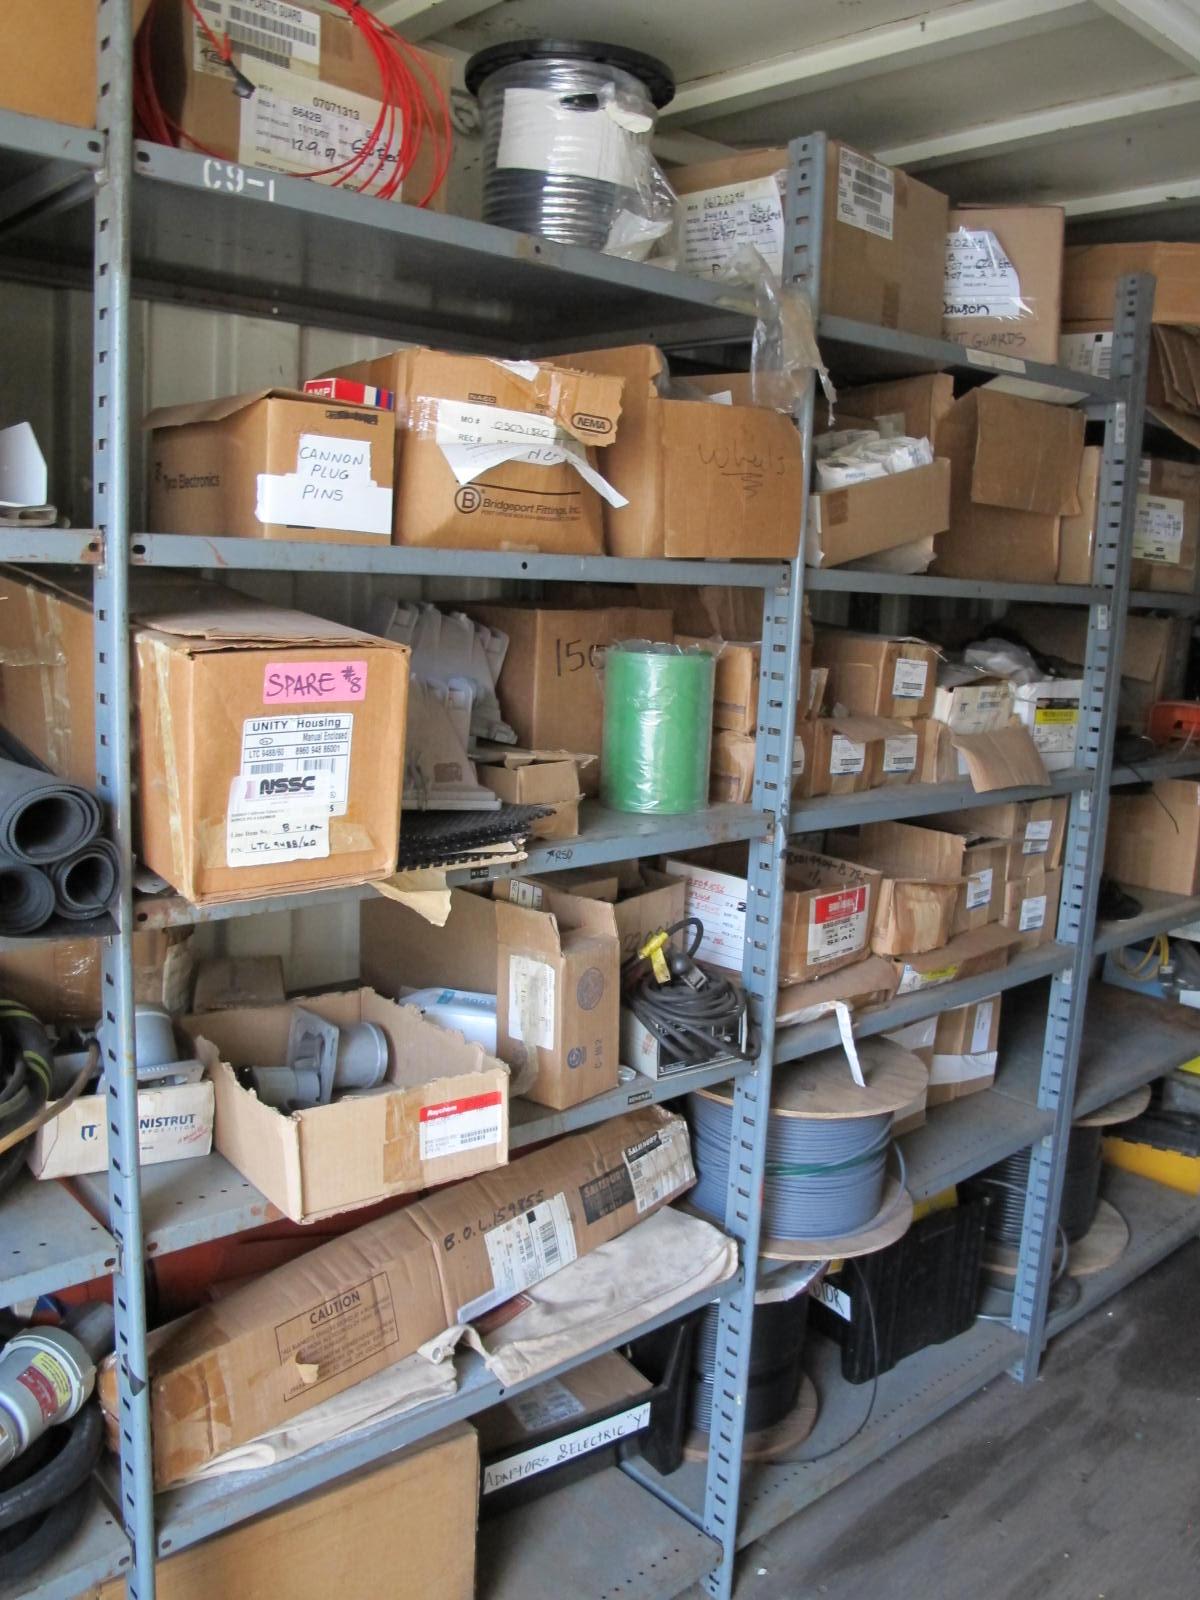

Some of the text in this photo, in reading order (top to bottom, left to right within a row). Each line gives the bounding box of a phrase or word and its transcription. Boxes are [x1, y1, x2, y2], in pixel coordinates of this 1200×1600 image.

[203, 159, 275, 202] C9-1
[299, 446, 365, 466] CANNON
[310, 464, 350, 481] PLUG
[302, 484, 345, 502] PINS
[266, 672, 337, 698] SPARE
[252, 718, 342, 732] UNITY Housing
[259, 775, 316, 795] NSSC
[140, 1113, 196, 1129] NISTRUT
[309, 1290, 361, 1324] CAUTION
